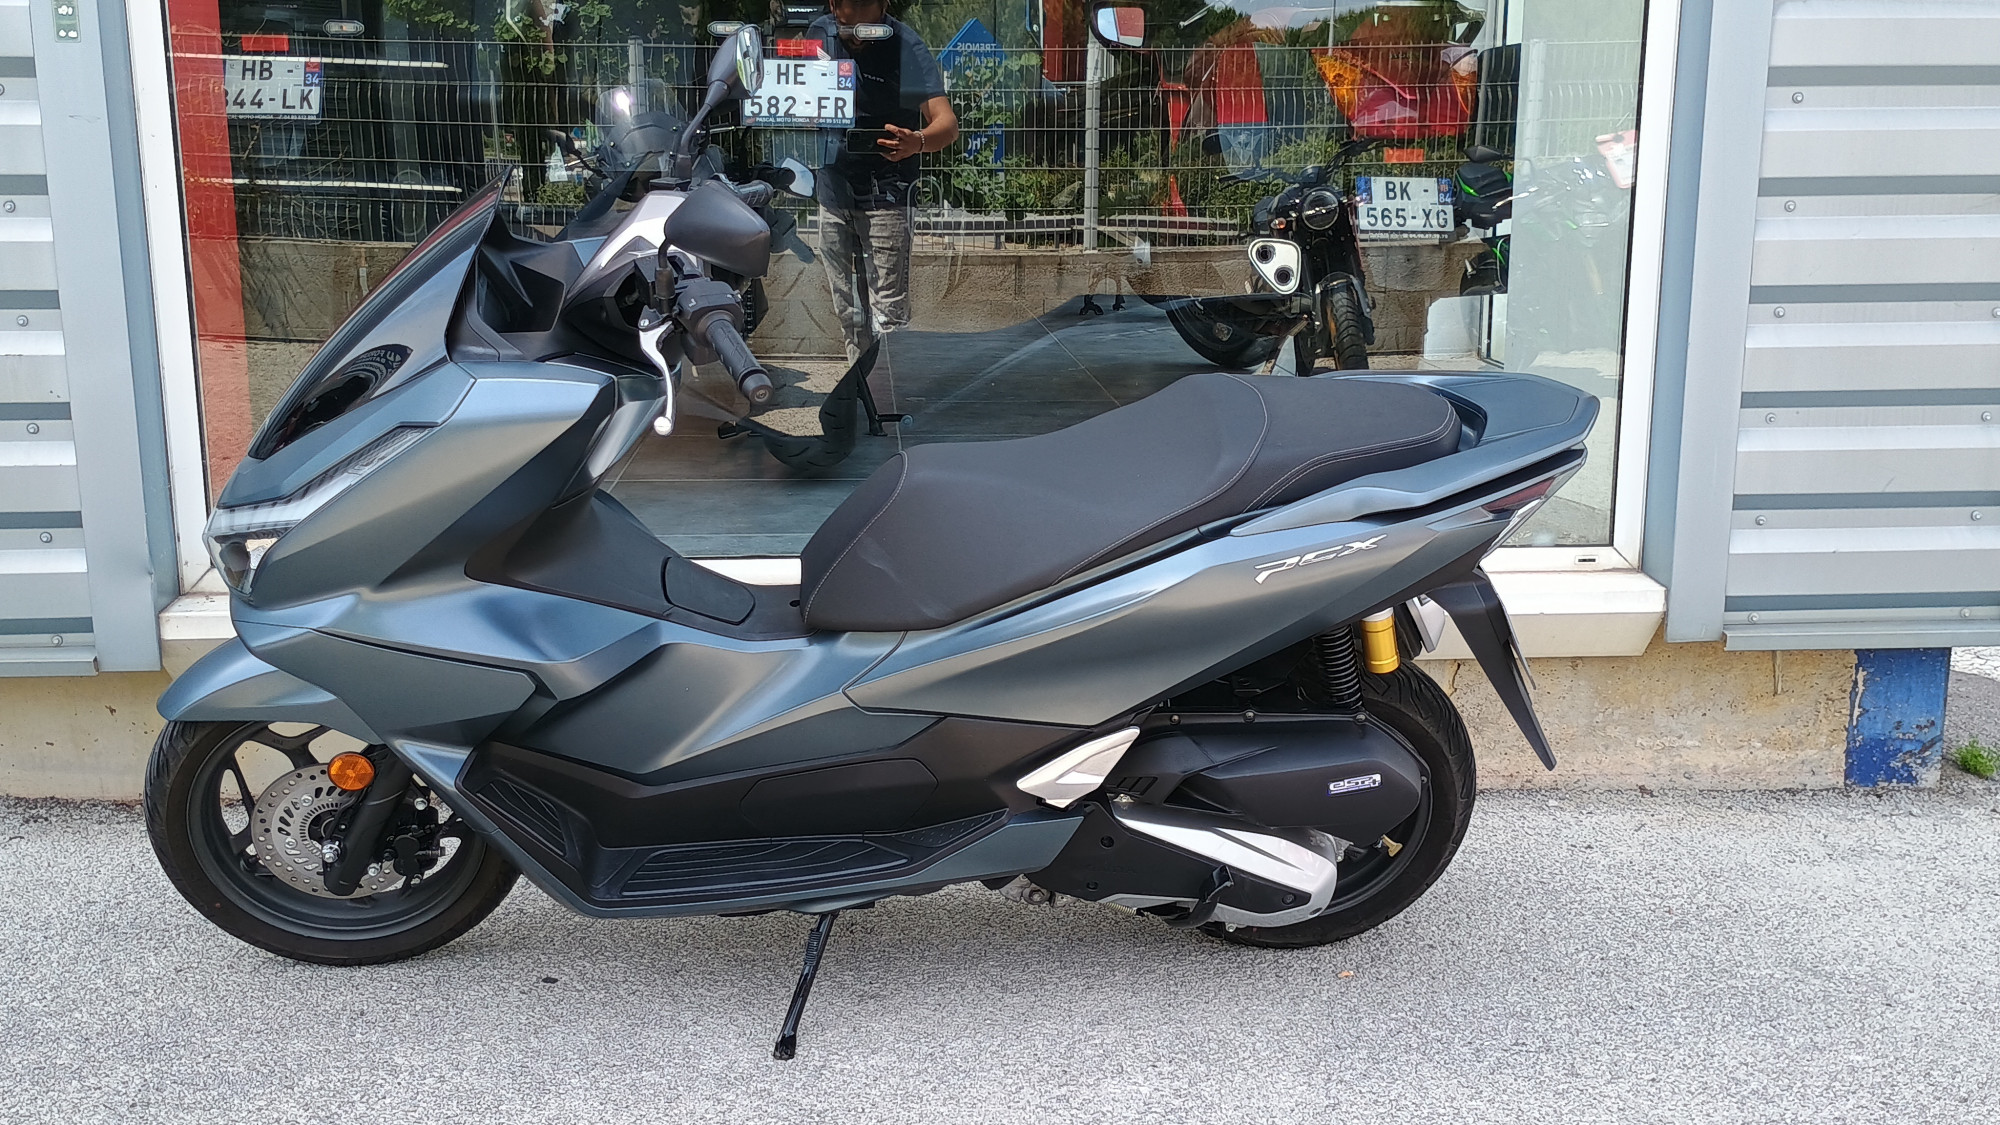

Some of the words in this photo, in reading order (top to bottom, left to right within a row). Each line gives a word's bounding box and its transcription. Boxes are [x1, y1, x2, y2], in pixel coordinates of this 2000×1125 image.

[241, 59, 273, 81] HB
[305, 73, 319, 85] 34
[776, 63, 806, 85] HE
[838, 77, 853, 89] 34
[1385, 181, 1412, 201] BK
[1439, 192, 1451, 203] 84
[1254, 533, 1387, 584] PCX
